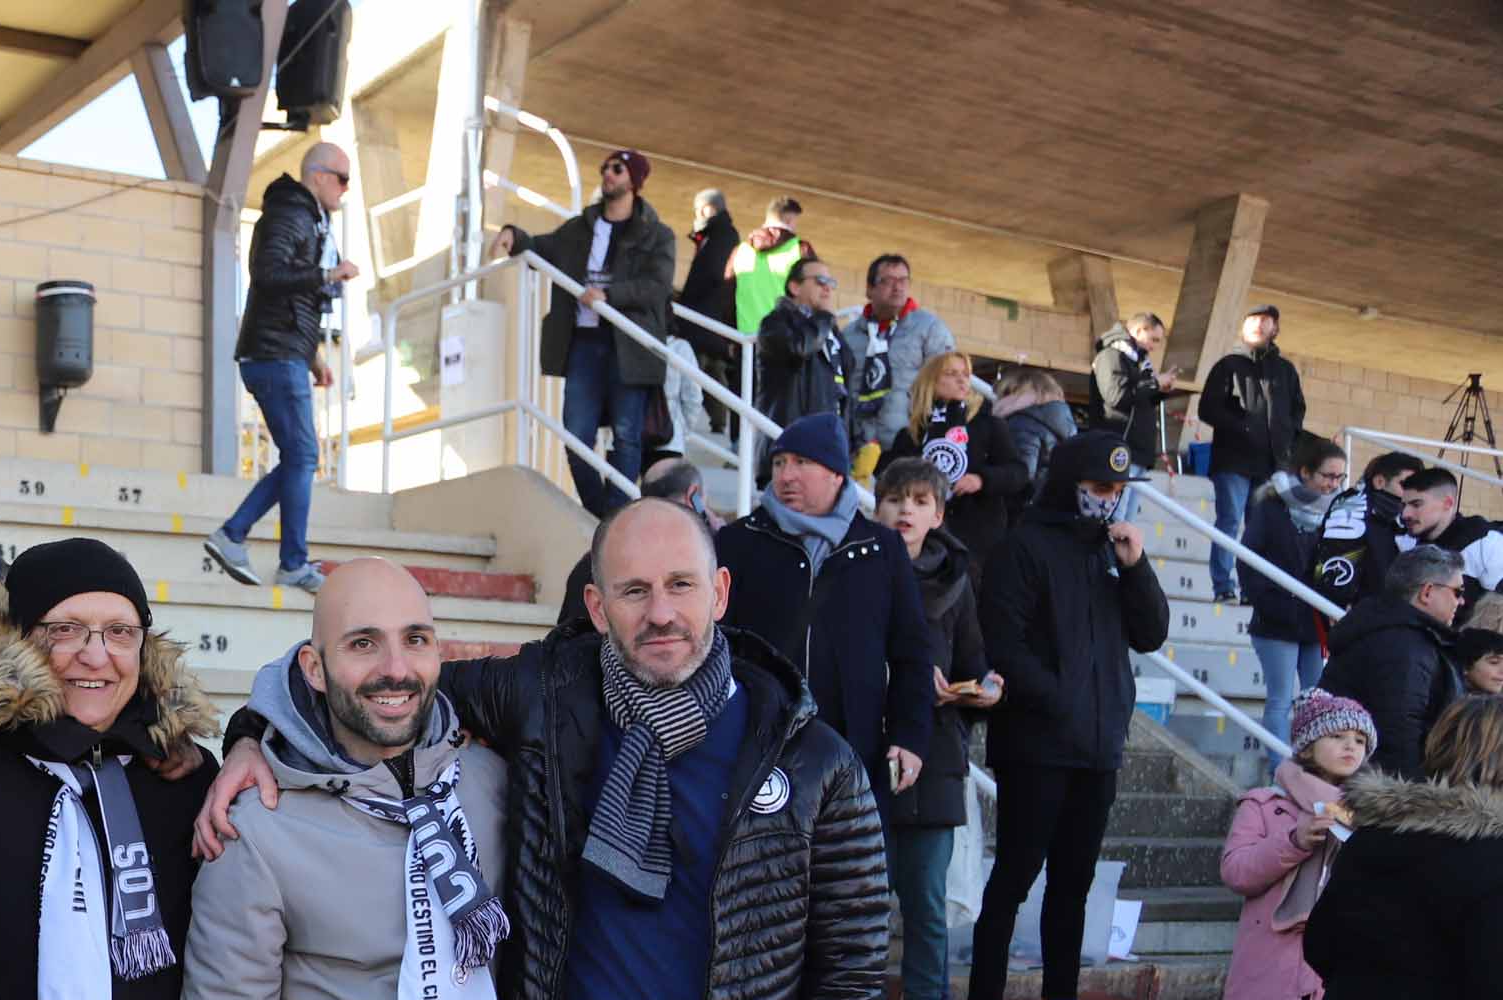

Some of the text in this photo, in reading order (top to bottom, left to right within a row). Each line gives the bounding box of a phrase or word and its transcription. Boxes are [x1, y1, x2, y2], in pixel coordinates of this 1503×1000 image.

[199, 634, 228, 652] 39
[114, 841, 155, 920] LOS
[411, 887, 436, 956] DESTINO
[420, 958, 437, 982] EL
